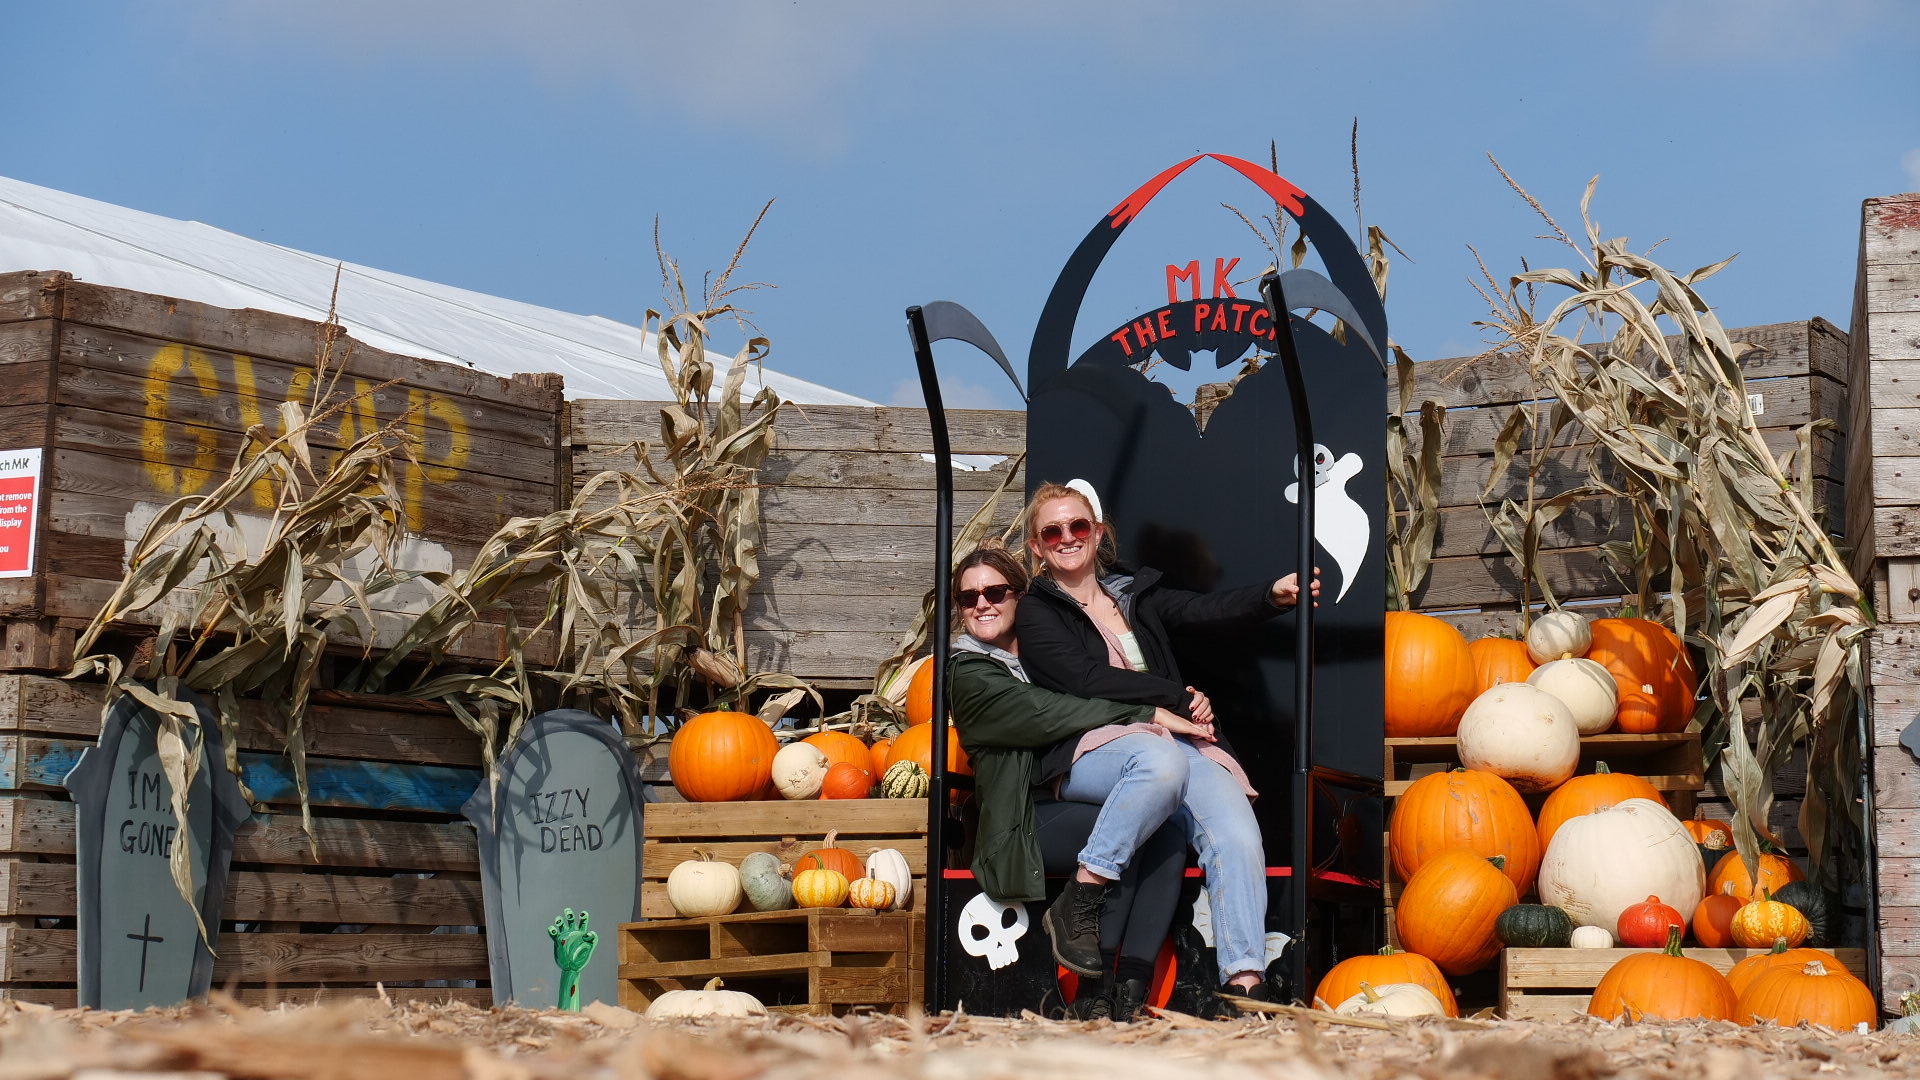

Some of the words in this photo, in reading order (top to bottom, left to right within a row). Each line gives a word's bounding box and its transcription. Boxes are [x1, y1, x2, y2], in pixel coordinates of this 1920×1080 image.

[1166, 257, 1241, 304] MK
[1111, 309, 1177, 357] THE
[12, 457, 30, 470] MK
[5, 492, 33, 501] remove
[0, 506, 14, 514] rom
[15, 504, 27, 513] the
[0, 518, 22, 529] isplay
[528, 787, 590, 825] IZZY
[540, 824, 604, 854] DEAD
